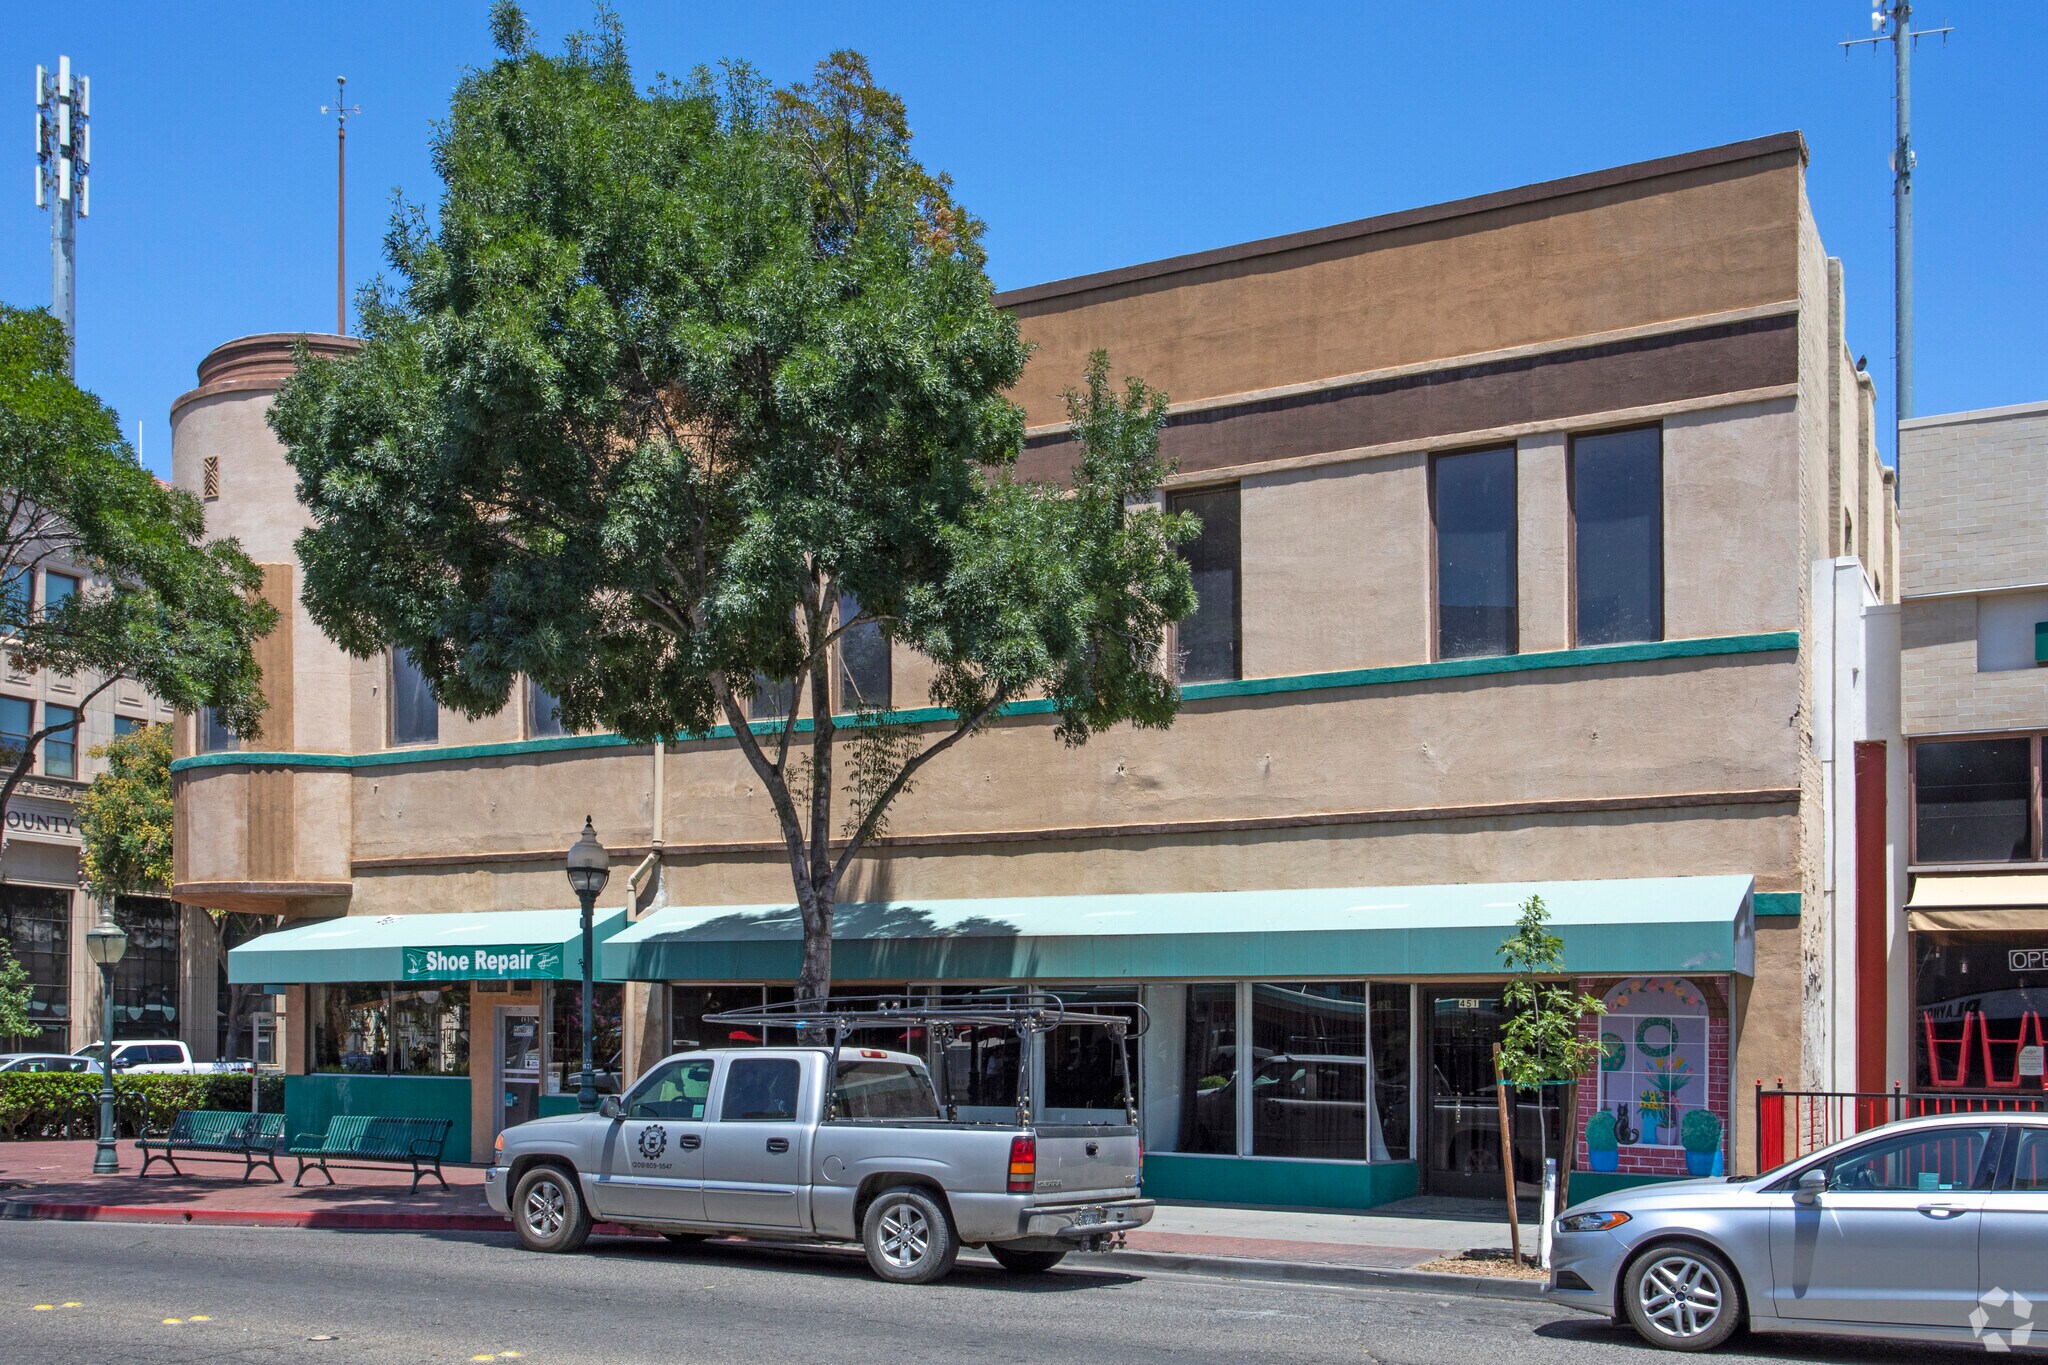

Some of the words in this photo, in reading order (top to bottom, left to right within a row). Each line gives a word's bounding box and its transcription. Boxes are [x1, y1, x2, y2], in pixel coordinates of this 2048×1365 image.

[426, 950, 470, 971] Shoe
[474, 949, 534, 975] Repair
[1459, 999, 1477, 1008] 451
